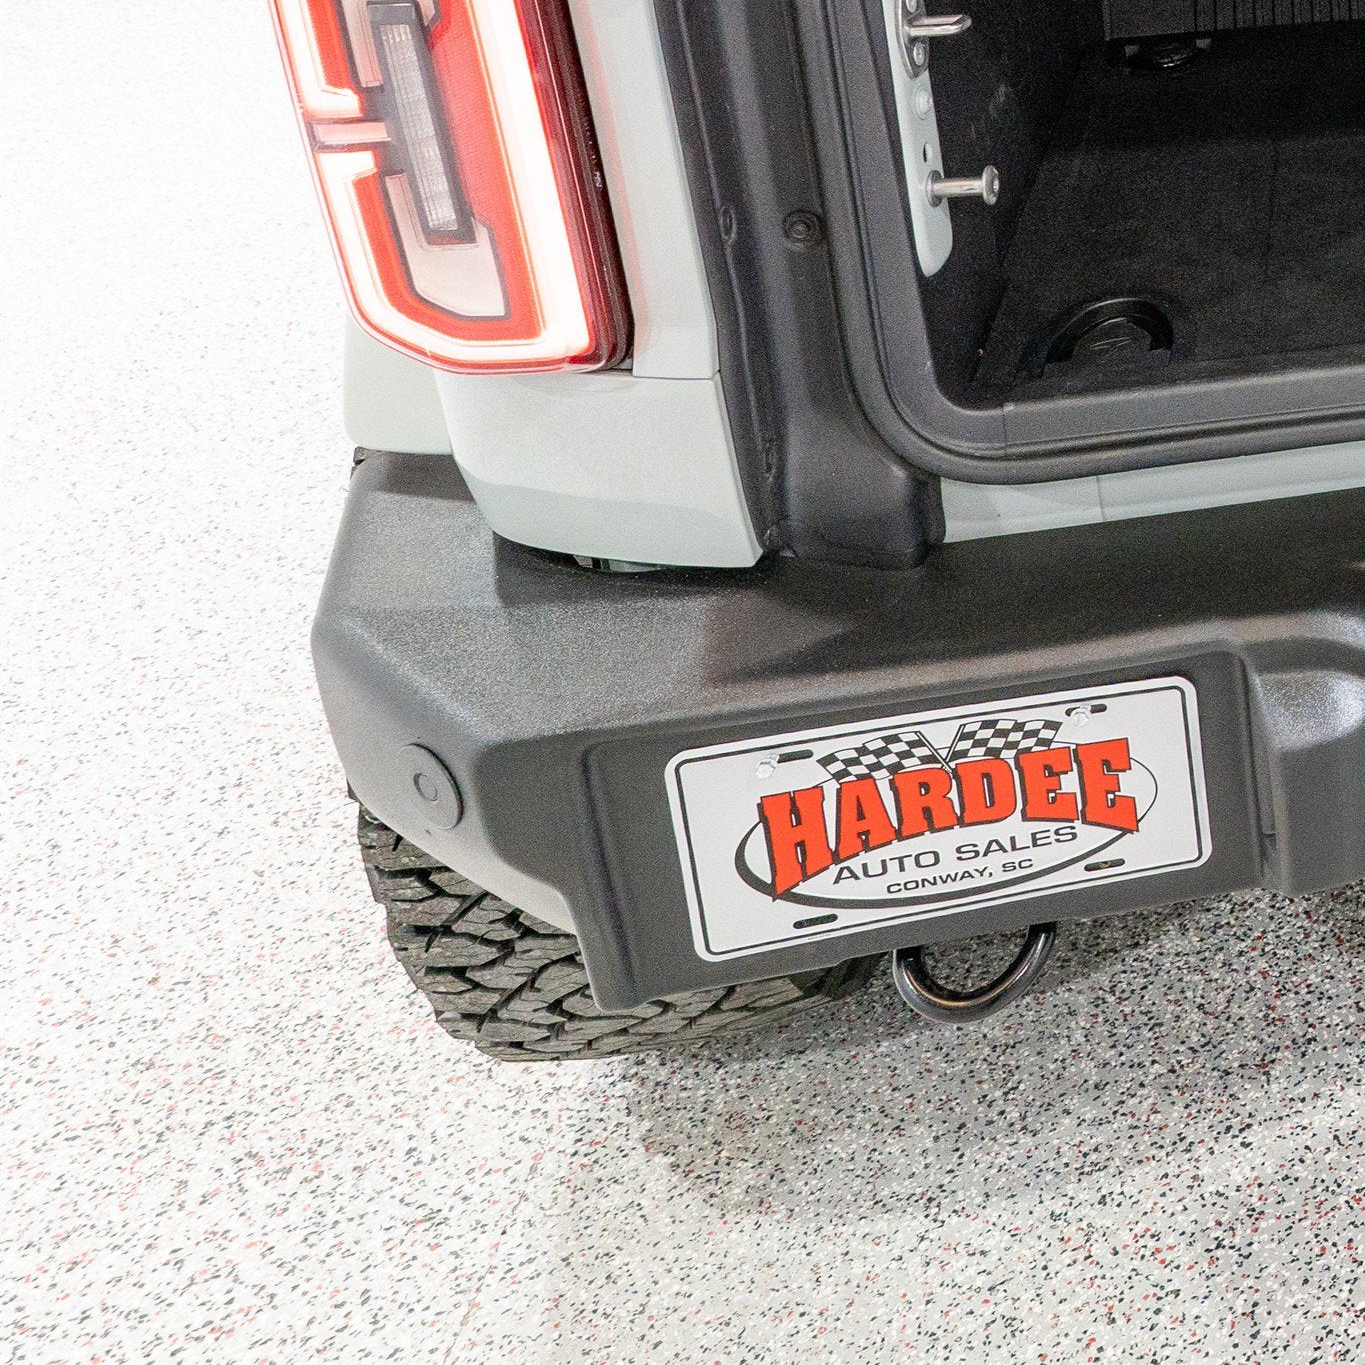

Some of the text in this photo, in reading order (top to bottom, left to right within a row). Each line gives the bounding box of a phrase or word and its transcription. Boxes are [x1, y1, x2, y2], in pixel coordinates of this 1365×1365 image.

[757, 737, 1139, 901] HARDEE
[832, 824, 1079, 885] AUTO SALES
[886, 857, 1034, 895] CONWAY, SC
